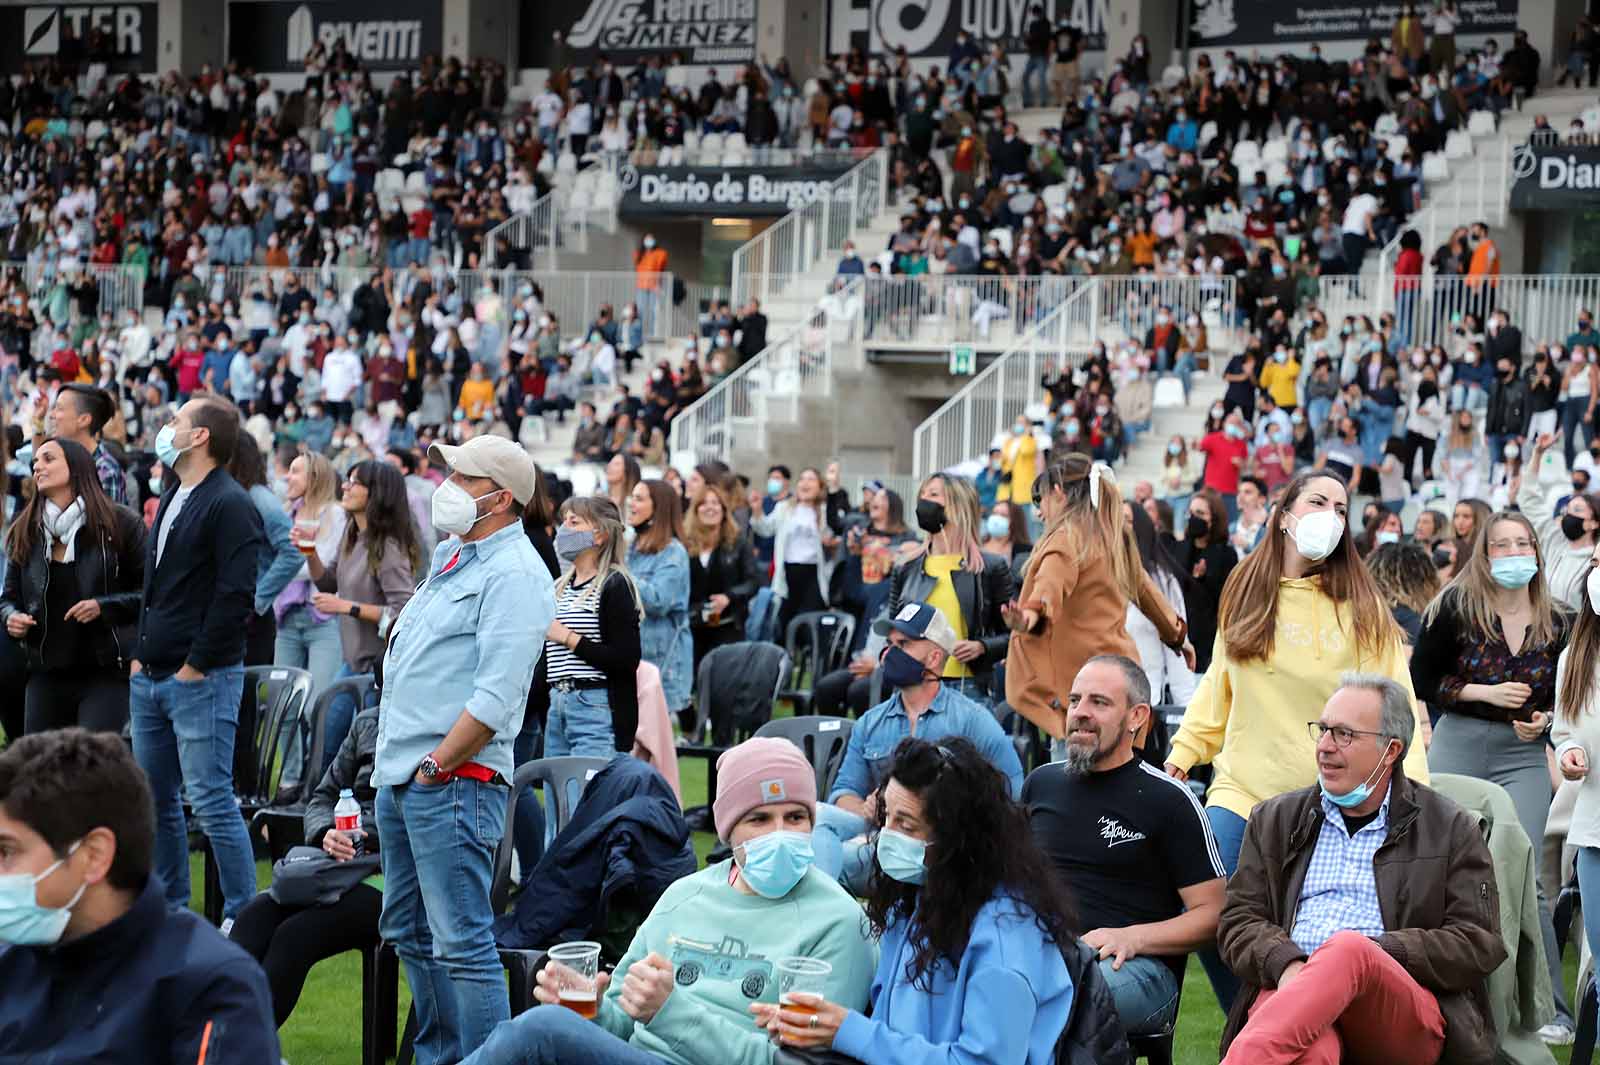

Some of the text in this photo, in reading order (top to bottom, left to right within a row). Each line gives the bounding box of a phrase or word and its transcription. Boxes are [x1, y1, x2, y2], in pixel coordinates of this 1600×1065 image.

[641, 174, 710, 202] Diario
[712, 172, 743, 202] de
[749, 175, 833, 209] Burgos
